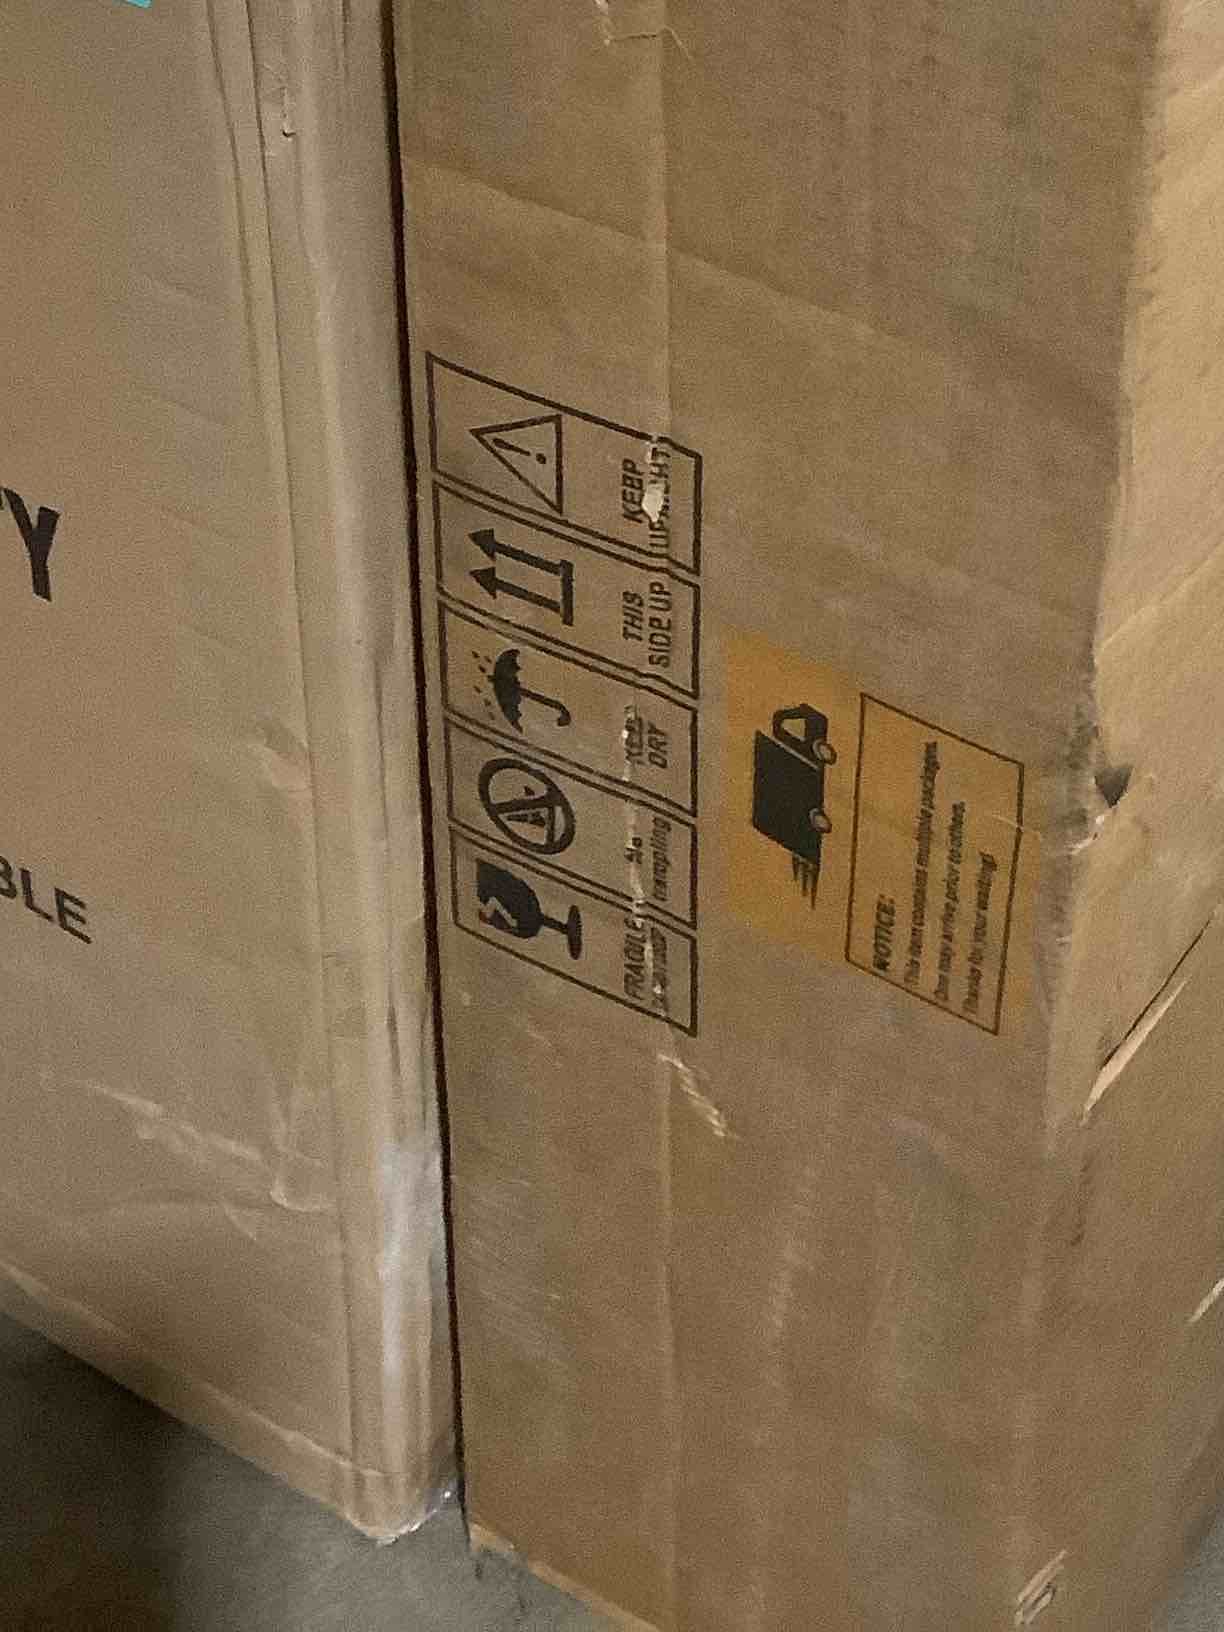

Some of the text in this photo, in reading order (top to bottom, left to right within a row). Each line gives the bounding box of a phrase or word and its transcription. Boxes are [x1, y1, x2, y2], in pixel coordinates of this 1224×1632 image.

[621, 458, 644, 524] KEEP
[622, 590, 645, 643] THIS
[648, 580, 672, 669] SIDE UP
[872, 894, 895, 972] NOTICE:
